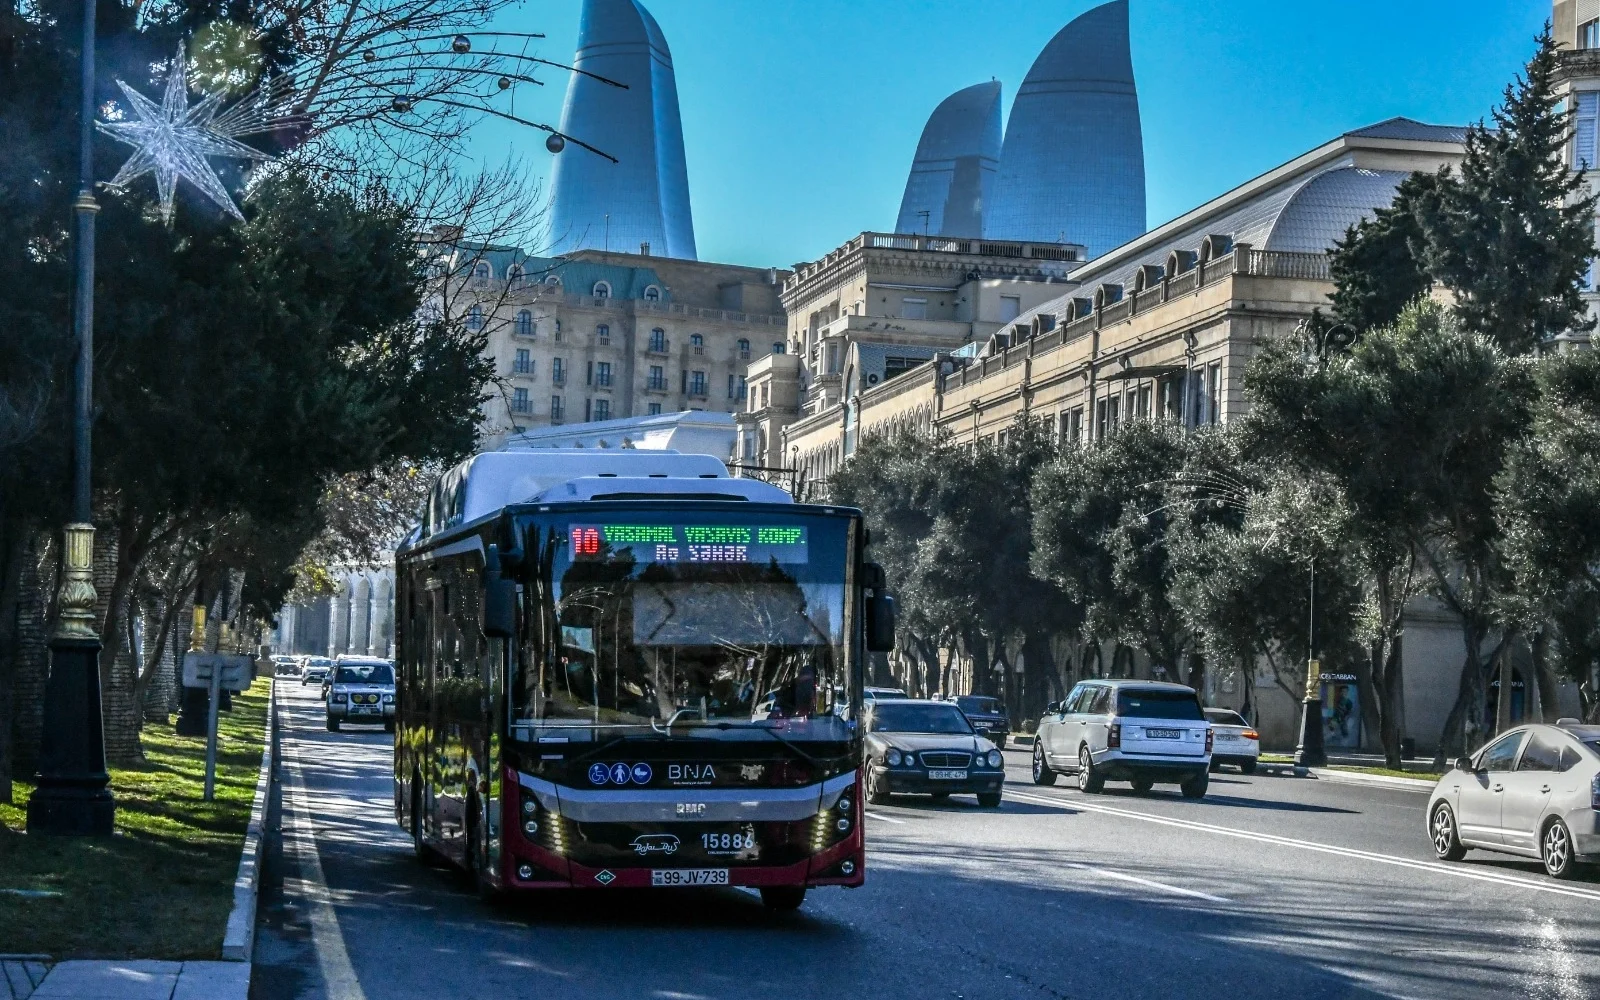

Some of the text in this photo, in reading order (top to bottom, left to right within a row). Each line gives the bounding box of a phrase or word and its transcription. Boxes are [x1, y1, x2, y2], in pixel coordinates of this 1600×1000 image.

[572, 528, 598, 553] 10
[758, 528, 806, 544] KOMP.
[668, 764, 716, 779] BNA
[701, 833, 754, 849] 15886
